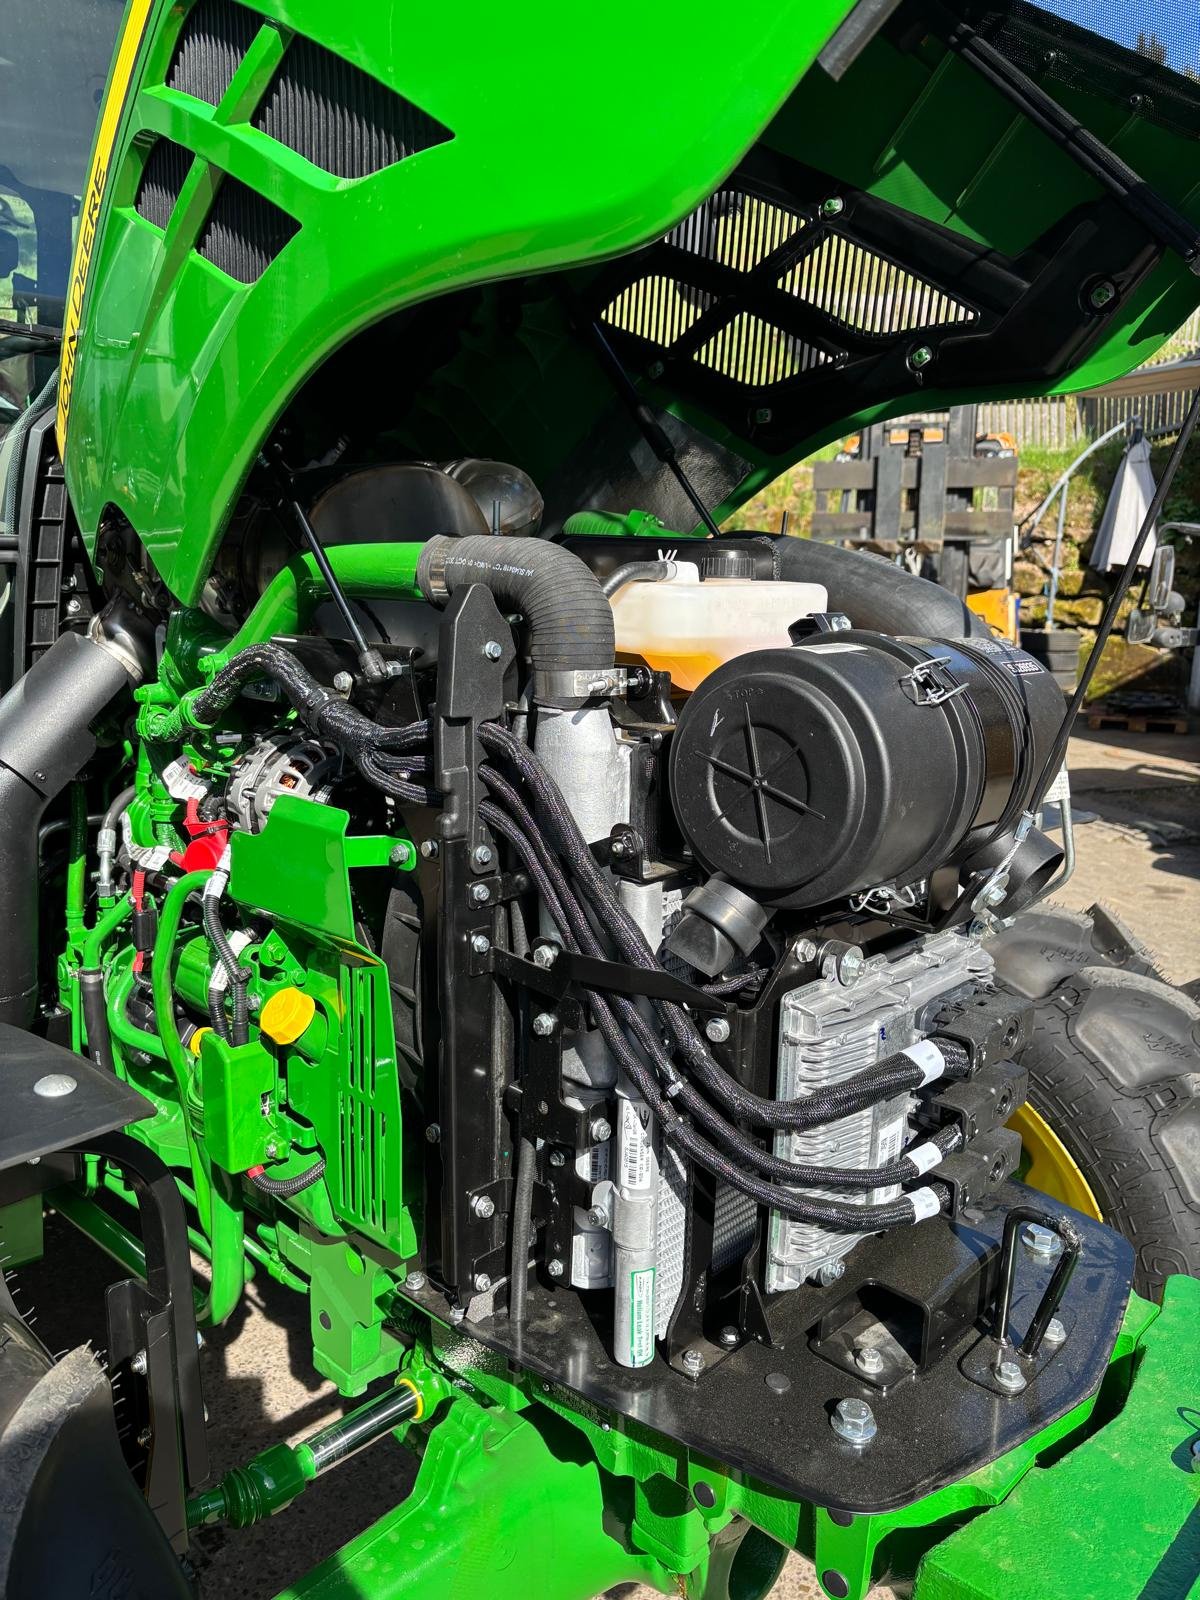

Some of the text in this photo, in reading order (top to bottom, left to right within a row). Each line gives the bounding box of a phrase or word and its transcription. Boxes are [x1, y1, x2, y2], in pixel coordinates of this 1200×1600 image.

[60, 156, 108, 433] JOHN DEERE
[636, 1299, 644, 1321] Helium
